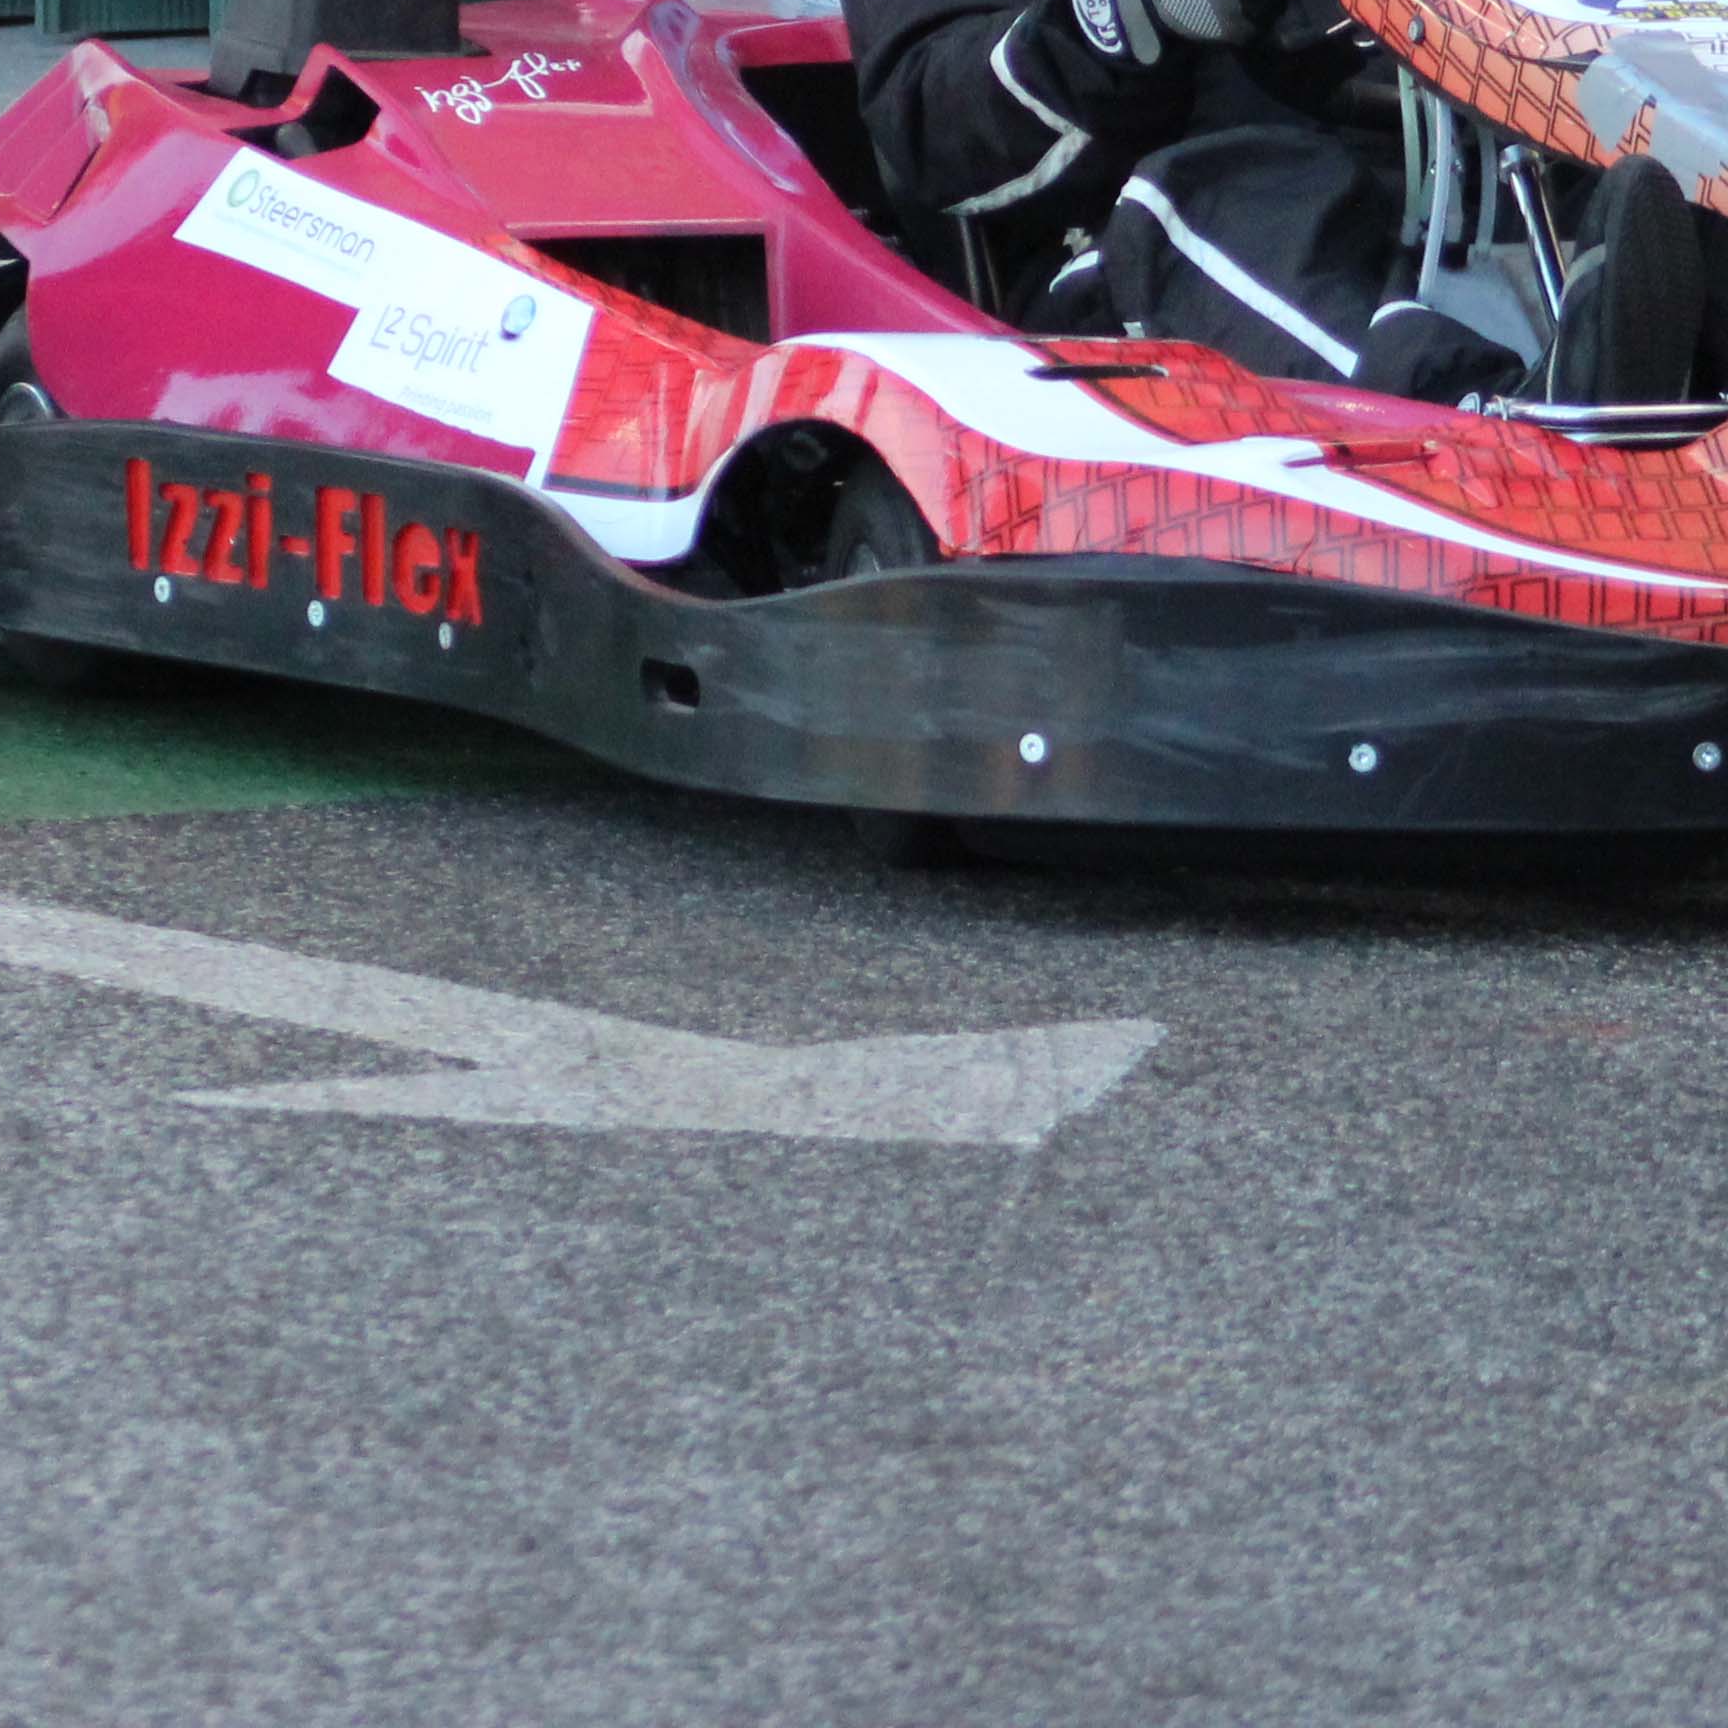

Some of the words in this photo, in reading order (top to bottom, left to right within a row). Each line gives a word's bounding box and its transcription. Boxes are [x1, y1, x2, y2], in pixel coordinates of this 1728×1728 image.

[248, 185, 376, 263] Steersman
[399, 313, 489, 373] Spirit
[125, 457, 483, 626] Izzi-Flex
